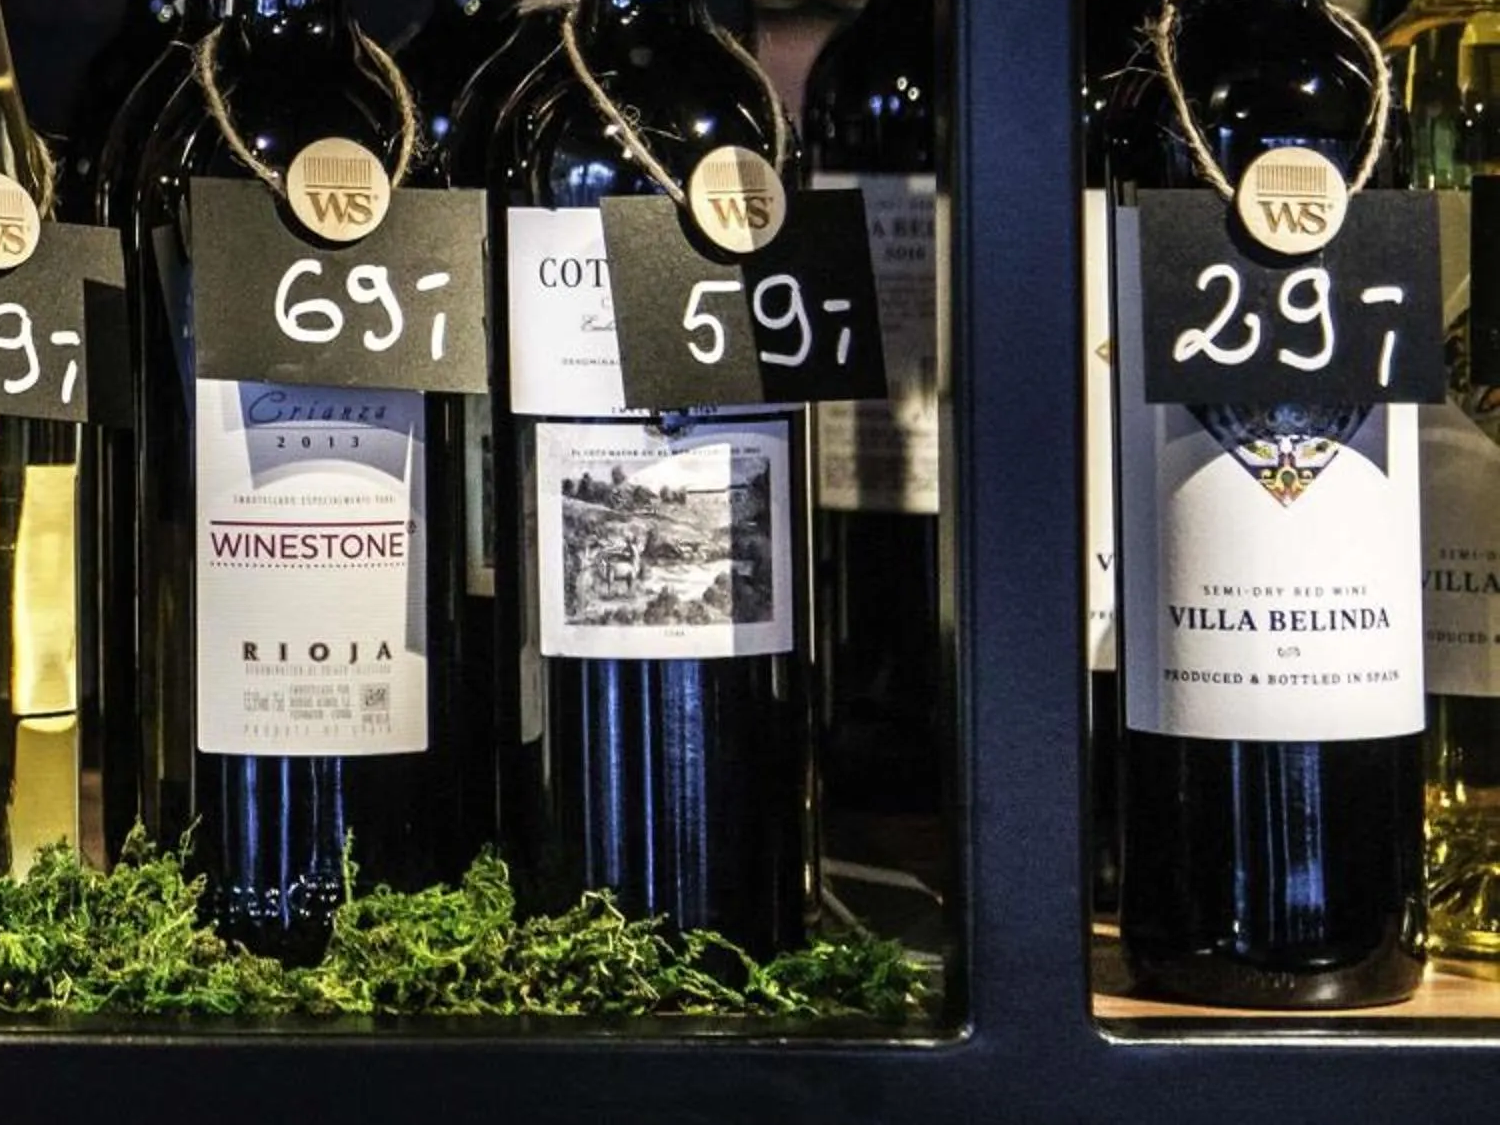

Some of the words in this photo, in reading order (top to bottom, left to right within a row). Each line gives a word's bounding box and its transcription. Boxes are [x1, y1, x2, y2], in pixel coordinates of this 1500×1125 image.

[539, 257, 609, 288] COT
[276, 435, 360, 449] 2013
[210, 531, 404, 560] WINESTONE
[1203, 586, 1284, 597] SEMI-DRY
[1168, 604, 1257, 632] VILLA
[1268, 607, 1391, 632] BELINDA
[242, 641, 392, 663] RIOJA
[1164, 668, 1243, 684] PRODUCED
[1267, 674, 1341, 685] BOTTLED
